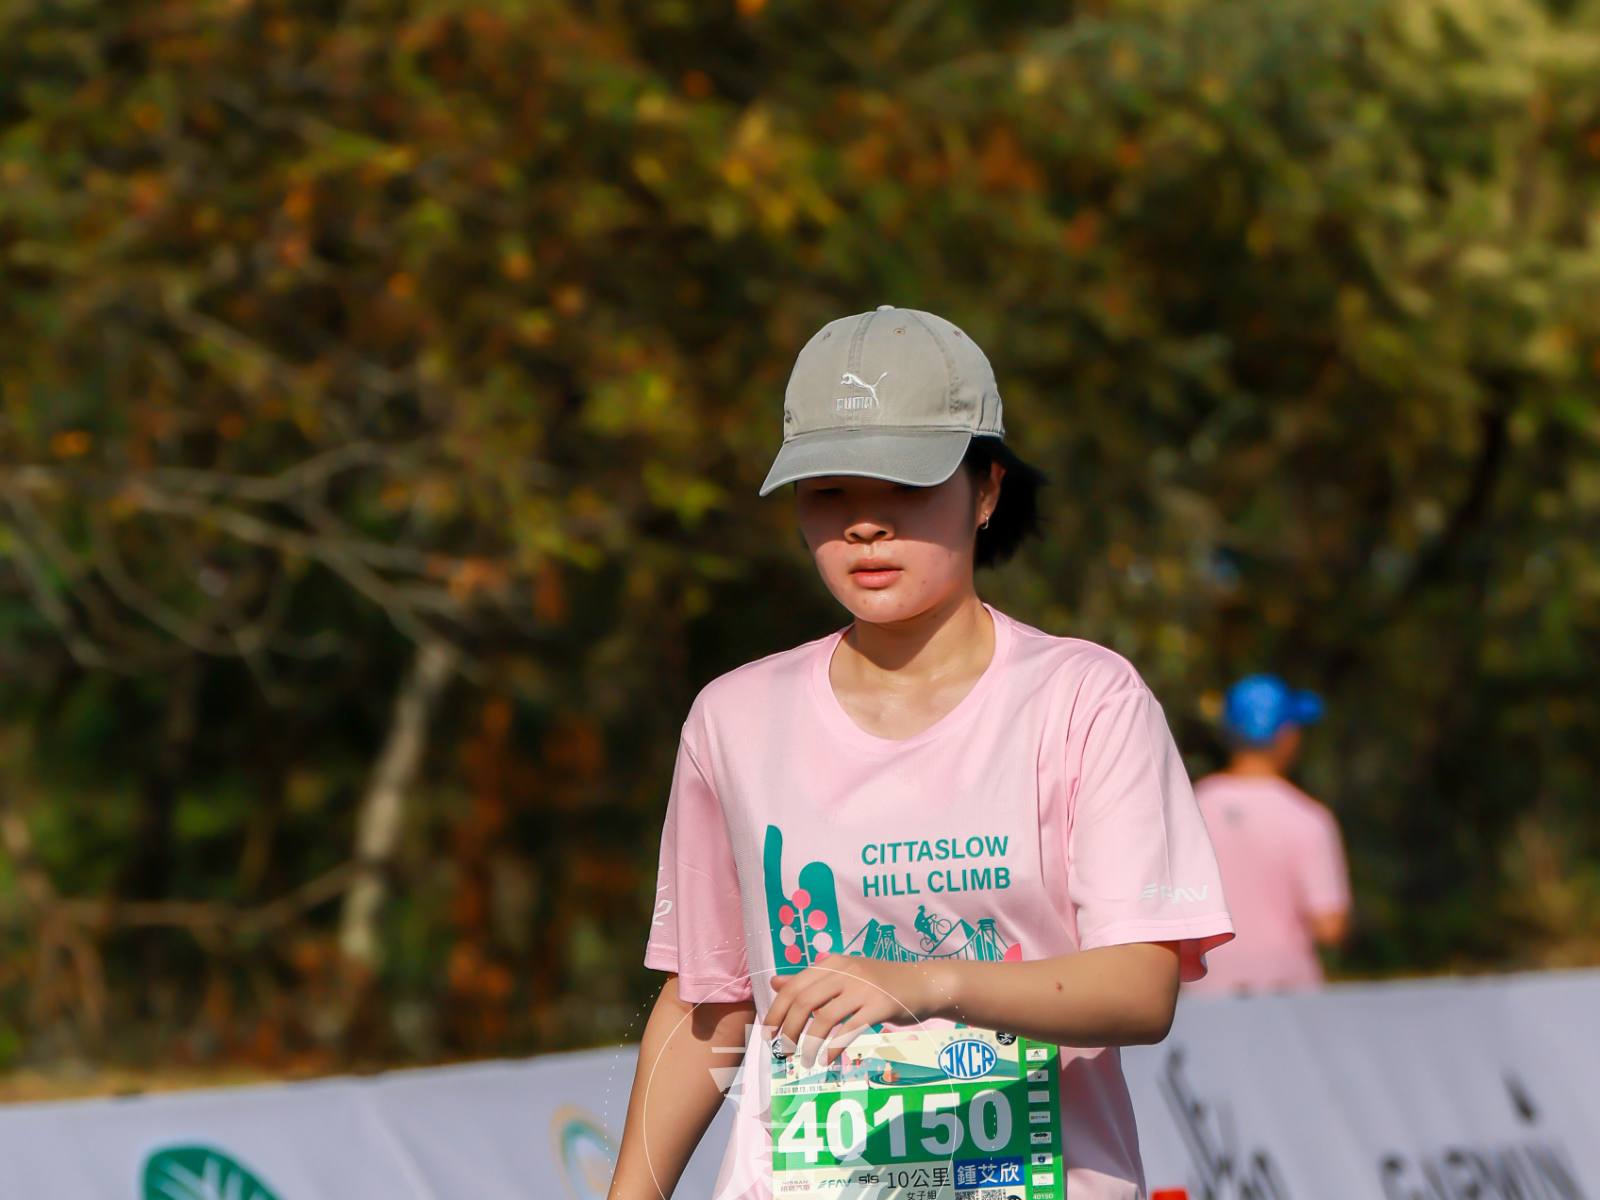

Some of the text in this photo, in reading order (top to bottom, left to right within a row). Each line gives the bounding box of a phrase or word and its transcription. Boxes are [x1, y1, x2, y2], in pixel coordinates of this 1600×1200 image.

[861, 835, 1009, 866] CITTASLOW
[862, 867, 1011, 898] HILL CLIMB
[943, 1042, 994, 1077] JKCR
[778, 1089, 1012, 1163] 40150
[887, 1167, 951, 1189] 10公里
[957, 1162, 1020, 1186] 鍾艾欣
